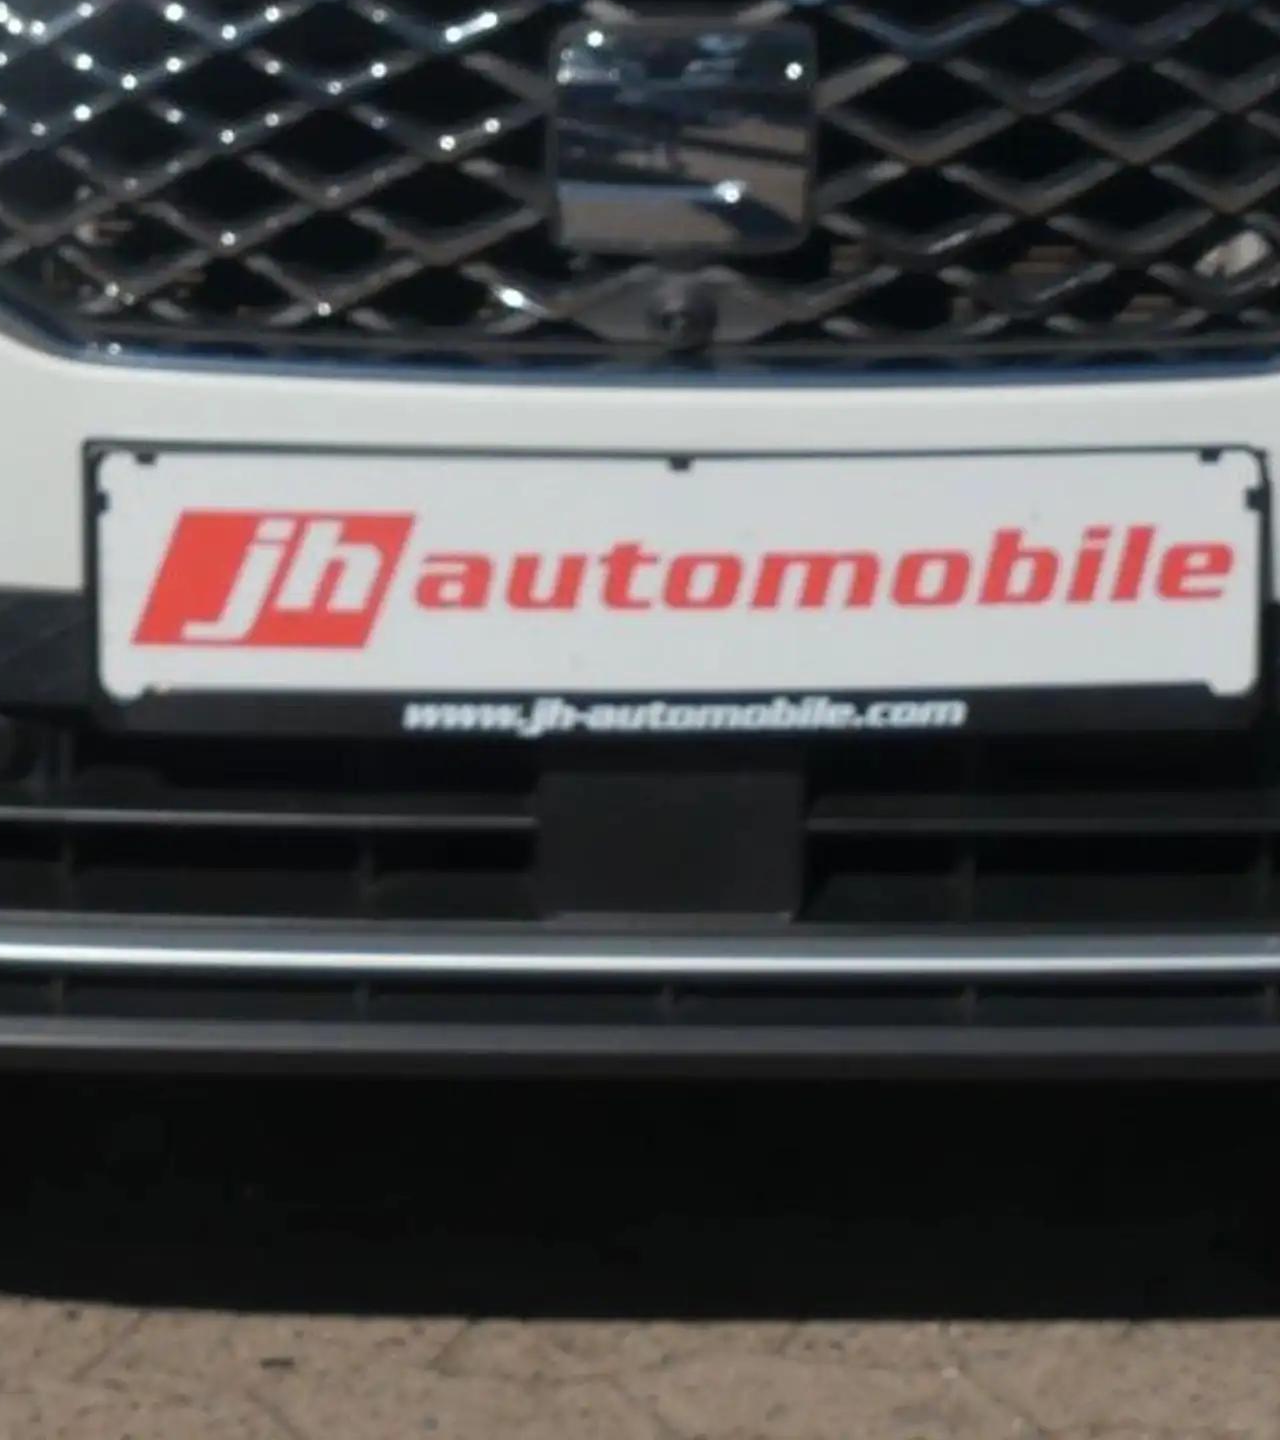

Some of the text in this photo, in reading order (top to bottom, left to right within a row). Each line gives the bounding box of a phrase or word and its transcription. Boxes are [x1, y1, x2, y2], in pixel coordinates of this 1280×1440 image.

[179, 517, 1233, 642] jh automobile
[402, 696, 968, 738] www.jh-automobile.com
